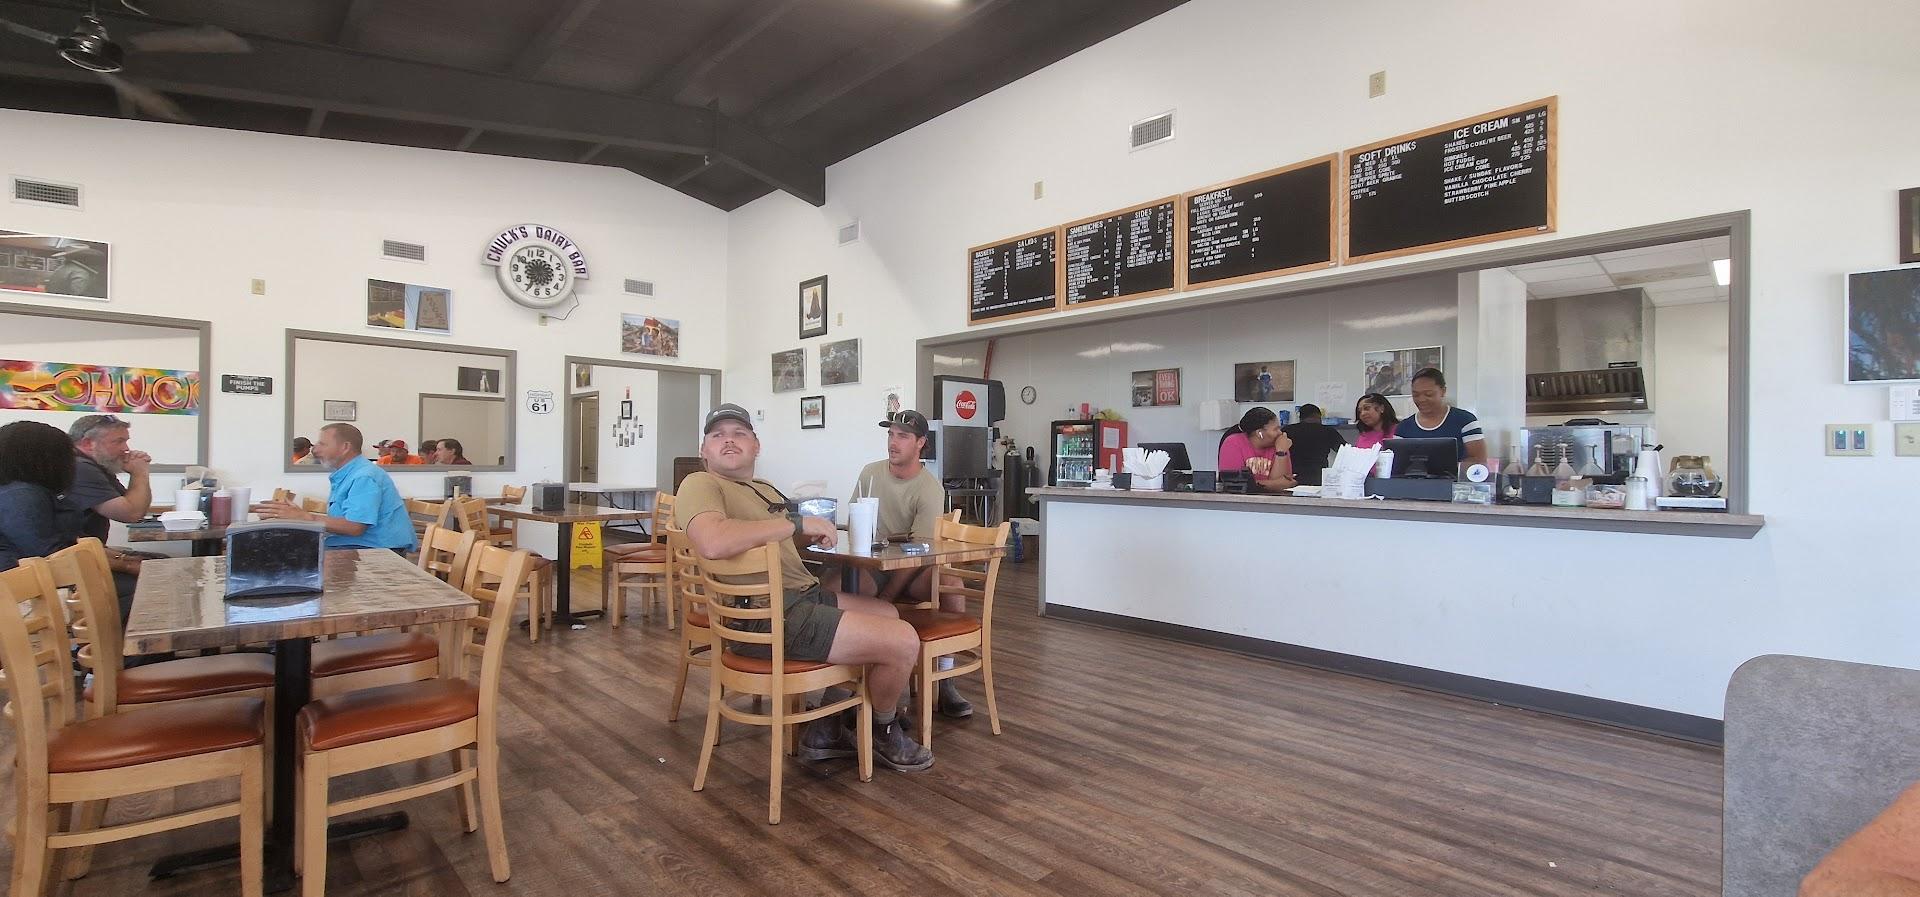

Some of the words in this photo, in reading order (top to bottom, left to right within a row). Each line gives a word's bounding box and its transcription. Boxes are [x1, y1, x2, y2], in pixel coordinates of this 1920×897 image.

[1453, 127, 1469, 140] ICE
[1472, 117, 1509, 135] CREAM
[1538, 110, 1547, 118] LG
[1359, 149, 1383, 163] SOFT
[1384, 141, 1417, 157] DRINKS
[1444, 143, 1470, 154] FROSTED
[1443, 160, 1455, 168] HOT
[1456, 155, 1476, 164] FUDGE
[1454, 161, 1475, 170] CREAM
[1475, 158, 1489, 166] CUP
[1475, 163, 1491, 171] CONE
[1443, 176, 1462, 185] SHAKE
[1468, 169, 1492, 179] SUNDAE
[1494, 163, 1523, 174] FLAVORS
[1444, 181, 1469, 191] VANILLA
[1471, 172, 1508, 186] CHOCOLATE
[1509, 167, 1533, 177] CHERRY
[1366, 178, 1380, 186] BEER
[1194, 188, 1231, 205] BREAKFAST
[1350, 187, 1370, 196] COFFEE
[1444, 185, 1482, 198] STRAWBERRY
[1444, 191, 1490, 205] BUTTERSCOTCH
[1135, 208, 1153, 219] SIDES
[1069, 220, 1104, 235] SANDWICHES
[1017, 237, 1038, 248] SALADS
[487, 226, 528, 262] CHUCK'S
[535, 226, 572, 250] DAIRY
[568, 251, 586, 275] BAR
[527, 249, 534, 258] 11
[536, 249, 545, 258] 12
[975, 248, 995, 258] BASKETS
[512, 264, 519, 272] 9
[555, 262, 561, 271] 2
[515, 274, 522, 282] 8
[553, 282, 559, 290] 4
[534, 288, 540, 296] 6
[545, 288, 551, 296] 5
[1160, 391, 1176, 402] OK
[532, 403, 547, 412] 61
[956, 399, 976, 410] Coca-Cola
